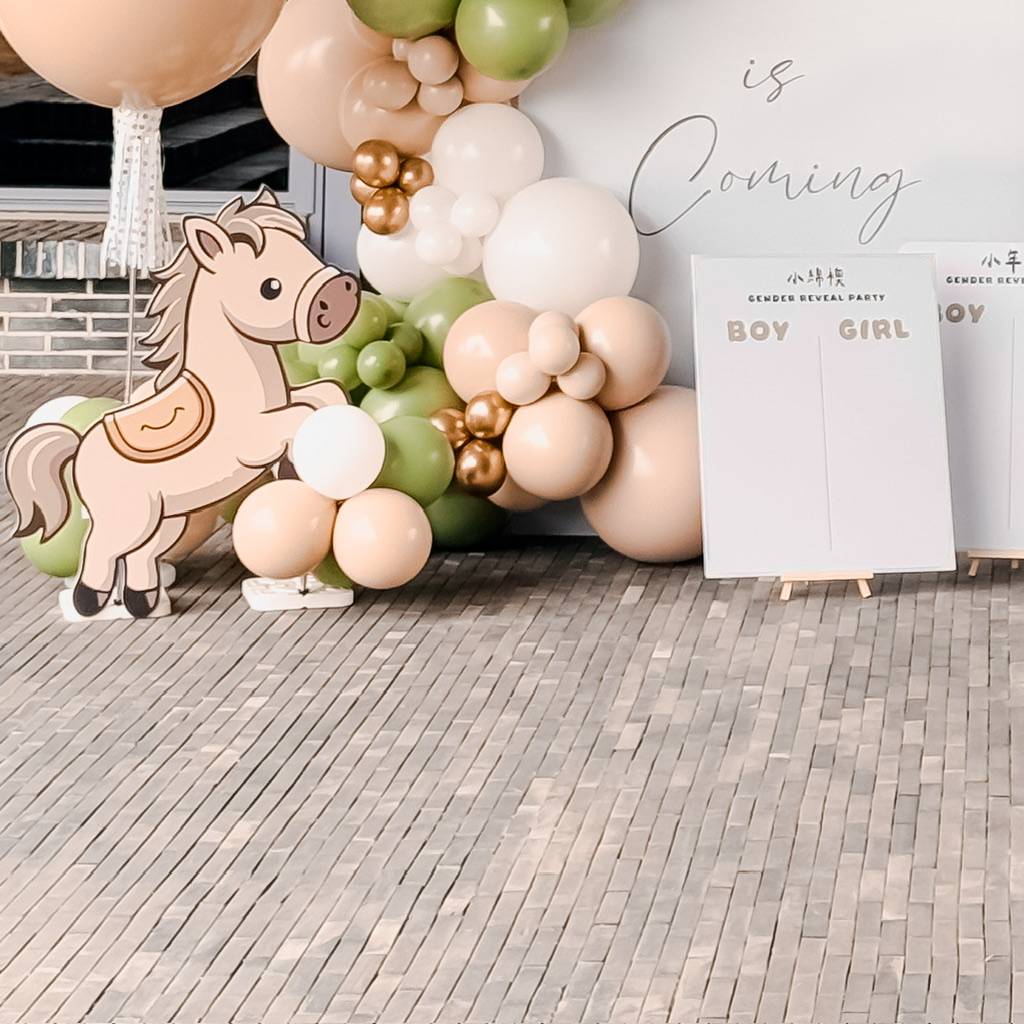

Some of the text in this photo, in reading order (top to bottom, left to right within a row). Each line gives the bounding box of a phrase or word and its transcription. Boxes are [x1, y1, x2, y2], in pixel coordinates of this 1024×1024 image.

[743, 59, 805, 103] is
[629, 114, 922, 245] Coming
[946, 276, 993, 285] GENDER
[748, 293, 885, 303] GENDER REVEAL PARTY
[727, 320, 789, 342] BOY
[839, 319, 910, 340] GIRL
